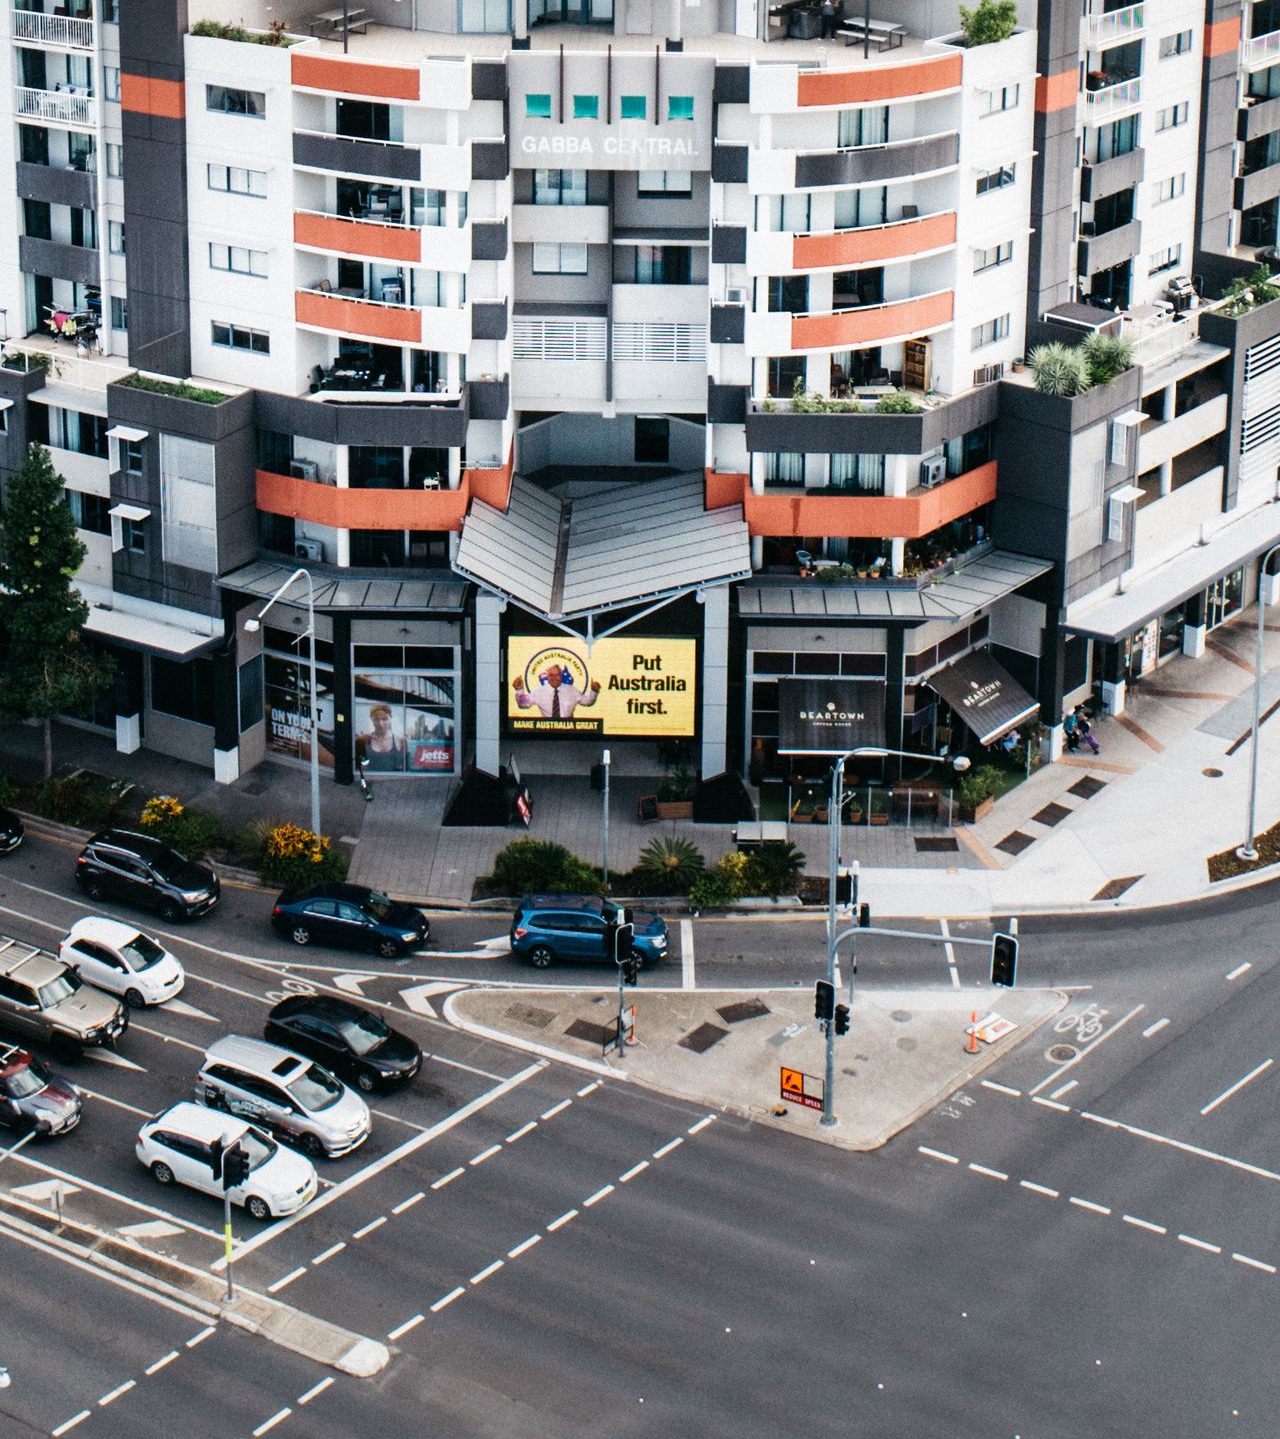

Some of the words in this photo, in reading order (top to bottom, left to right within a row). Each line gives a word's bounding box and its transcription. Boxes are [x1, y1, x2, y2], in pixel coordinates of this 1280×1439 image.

[522, 136, 593, 154] GABBA
[604, 136, 699, 156] CENTRAL
[632, 654, 662, 671] Put
[608, 674, 686, 692] Australia
[963, 679, 1002, 707] BEARTOWN
[627, 698, 668, 715] first.
[800, 711, 865, 720] BEARTOWN
[271, 708, 285, 723] ON
[286, 711, 312, 730] YOUR
[513, 720, 535, 729] MAKE
[536, 720, 574, 730] AUSTRALIA
[575, 721, 598, 730] GREAT
[271, 722, 310, 743] TERMS.
[420, 749, 449, 761] jetts
[783, 1091, 802, 1103] REDUCE
[805, 1098, 821, 1109] SPEED
